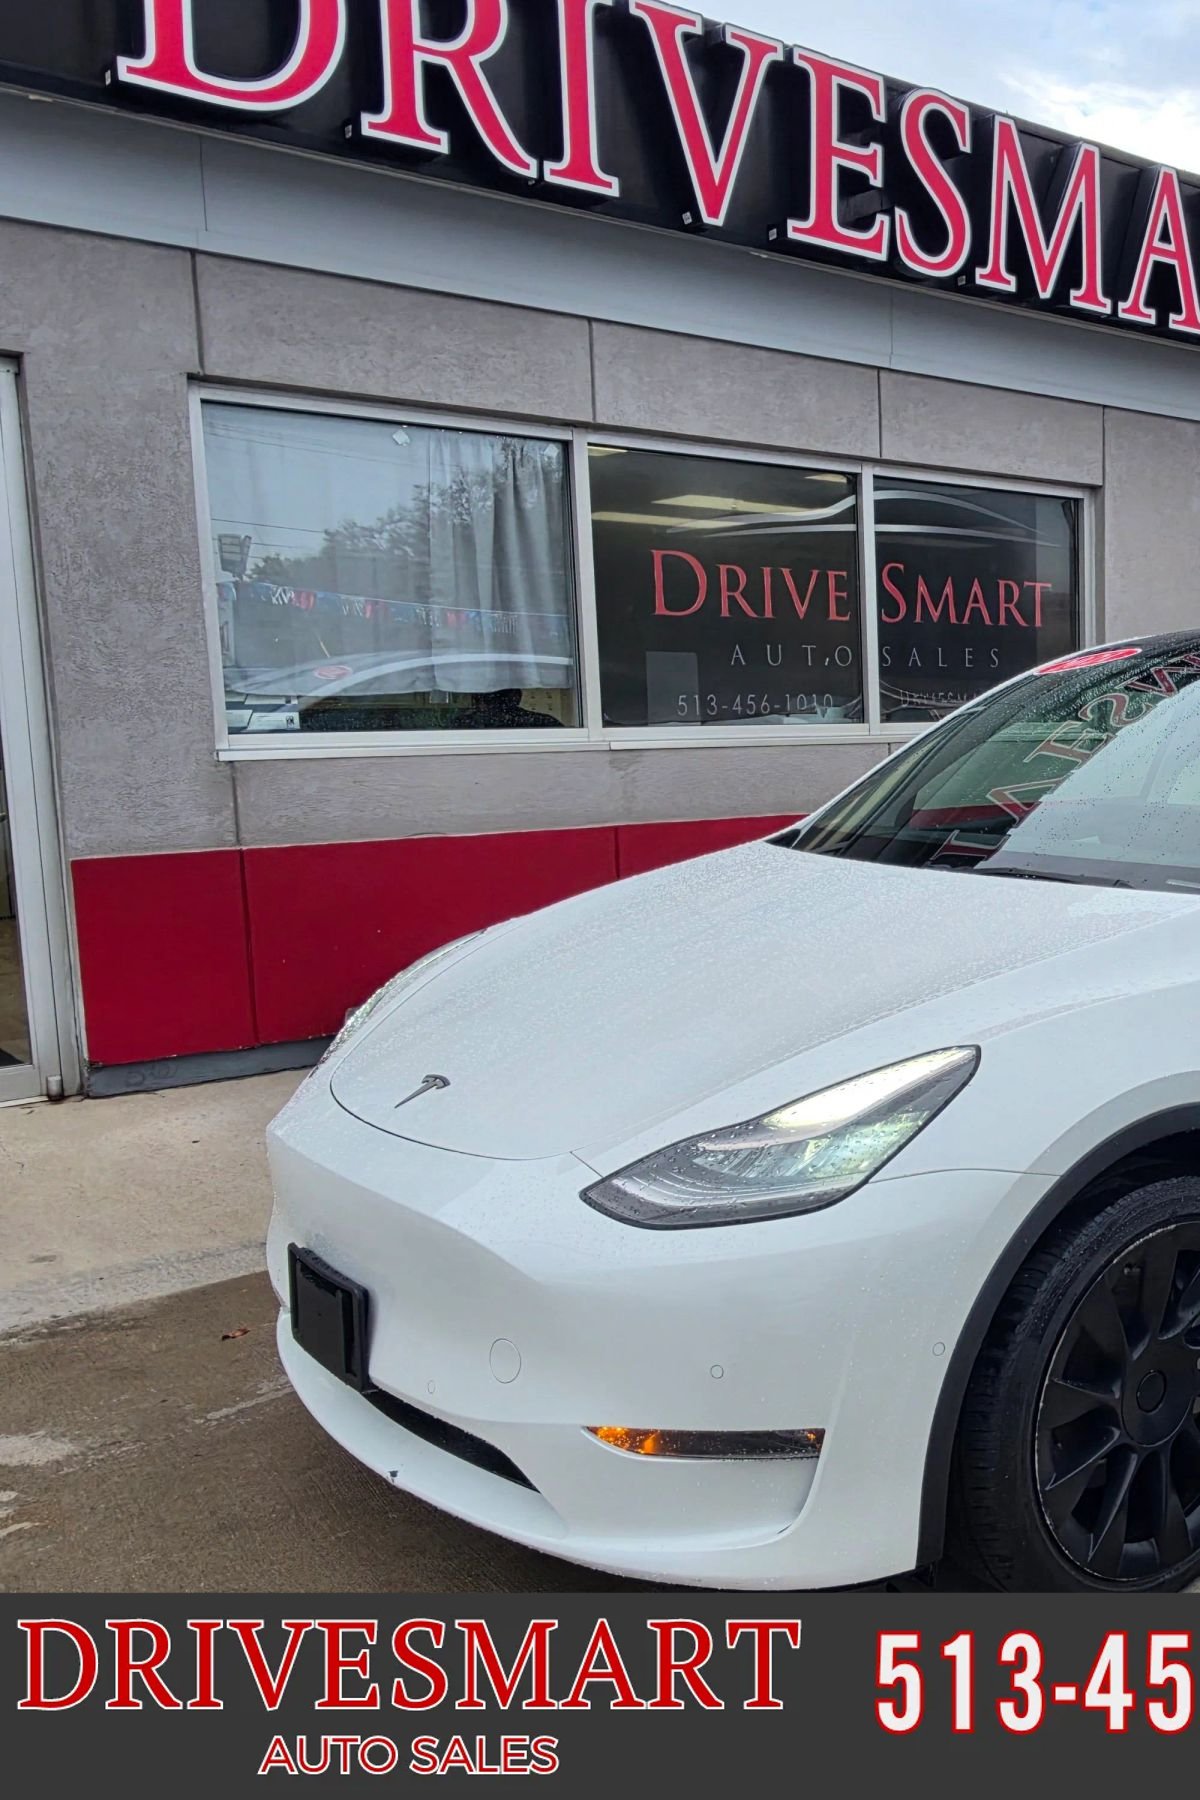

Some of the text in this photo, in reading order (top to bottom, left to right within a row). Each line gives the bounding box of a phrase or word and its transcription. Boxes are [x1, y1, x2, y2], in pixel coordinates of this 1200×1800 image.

[650, 548, 1054, 629] DRIVE SMART
[730, 643, 1001, 669] AUTO SALES
